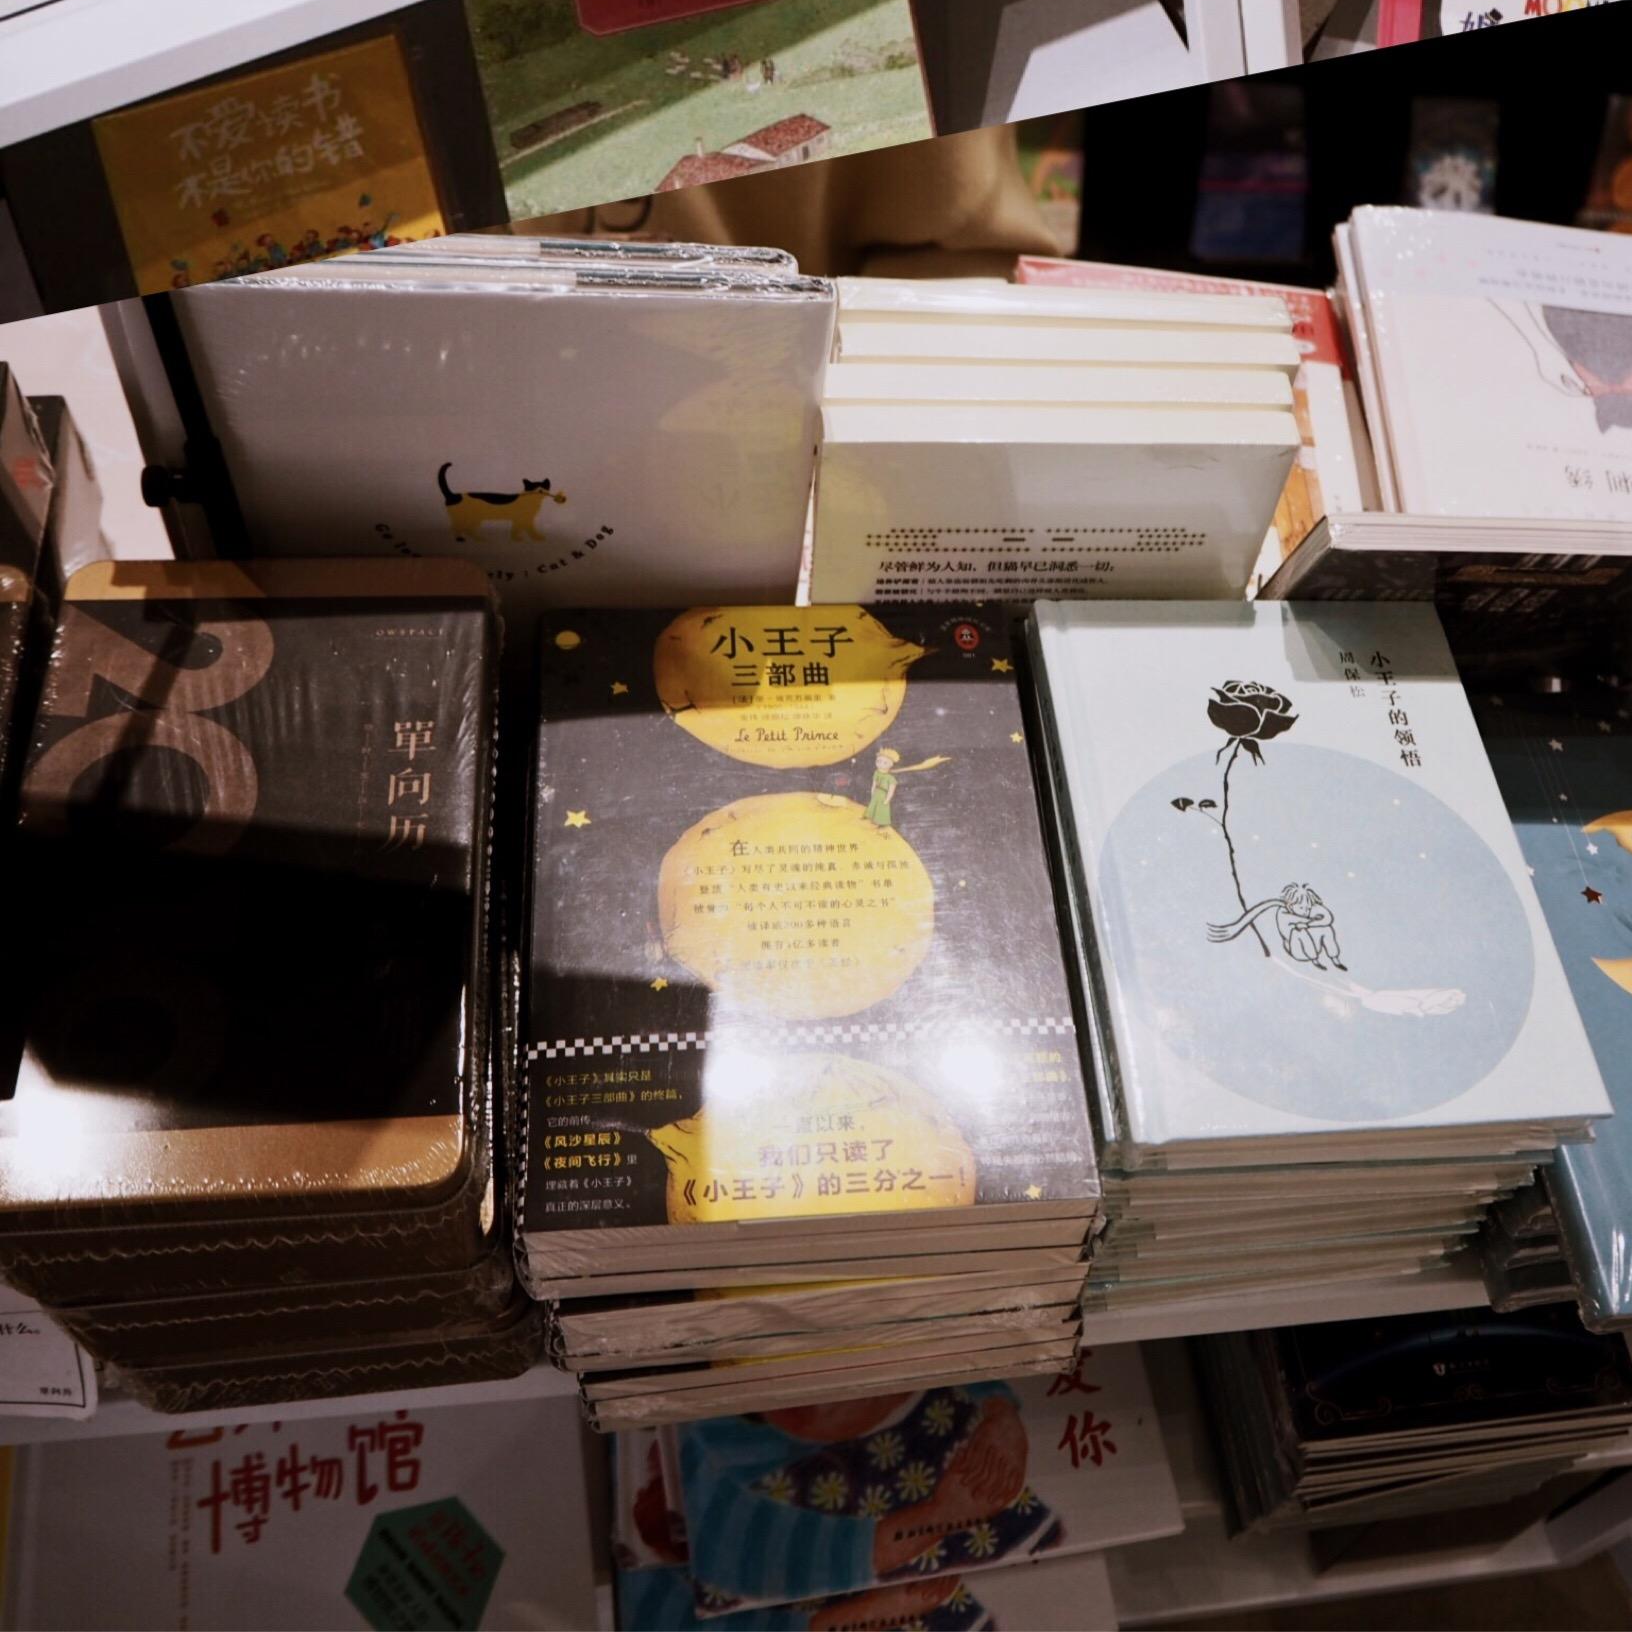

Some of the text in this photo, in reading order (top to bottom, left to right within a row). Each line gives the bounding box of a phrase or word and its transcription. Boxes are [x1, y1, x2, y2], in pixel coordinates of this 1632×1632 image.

[584, 523, 615, 552] Dog
[710, 626, 856, 661] 小王子
[730, 662, 832, 688] 三部曲
[1338, 650, 1367, 699] 周保松
[1369, 650, 1424, 769] 小王子的领悟
[734, 726, 840, 744] Le Petit Prince
[384, 719, 438, 854] 單向历
[543, 1131, 623, 1150] 《风沙星辰》
[757, 1138, 895, 1167] 我们只读了
[198, 1420, 426, 1555] 博物馆
